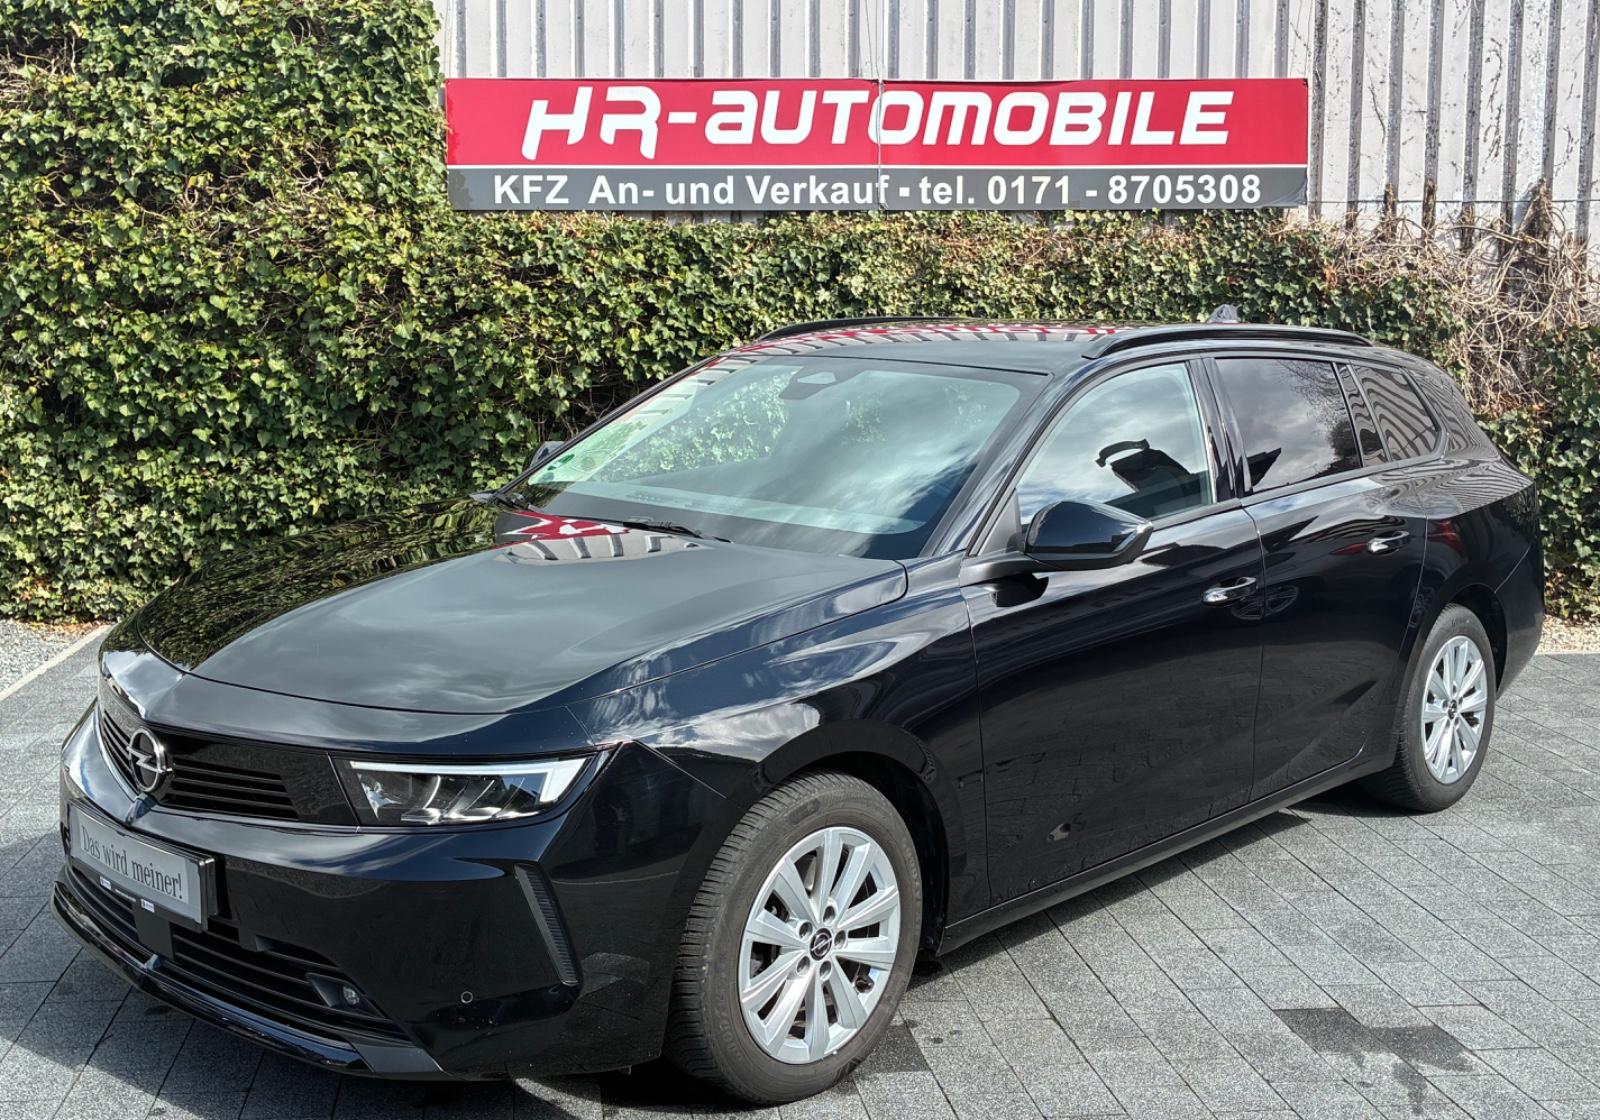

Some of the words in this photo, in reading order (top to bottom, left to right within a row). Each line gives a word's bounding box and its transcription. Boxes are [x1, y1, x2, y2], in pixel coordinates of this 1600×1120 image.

[494, 174, 569, 205] KFZ
[587, 175, 655, 205] An-
[665, 175, 734, 205] und
[745, 174, 890, 205] Verkauf
[919, 175, 975, 205] tel.
[987, 175, 1069, 205] 0171
[1107, 174, 1261, 205] 8705308
[82, 825, 100, 859] Das
[103, 845, 128, 876] wird
[131, 862, 183, 899] meiner!
